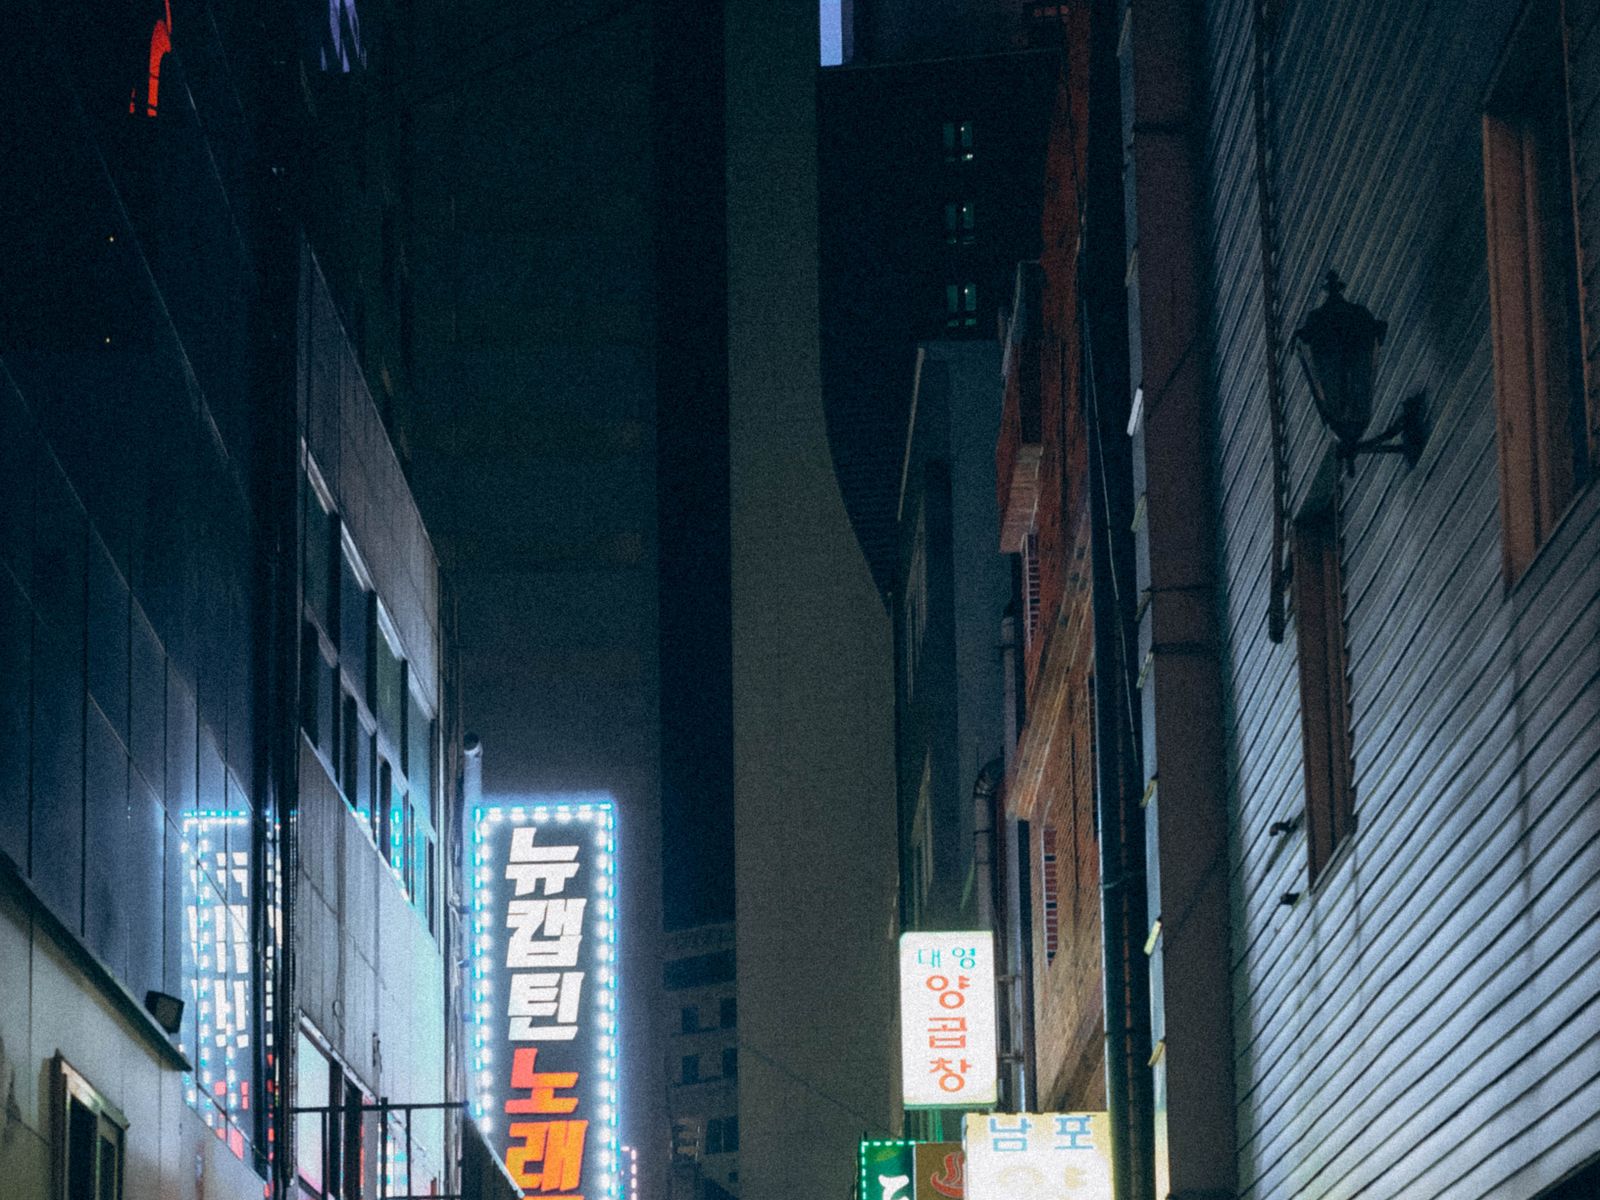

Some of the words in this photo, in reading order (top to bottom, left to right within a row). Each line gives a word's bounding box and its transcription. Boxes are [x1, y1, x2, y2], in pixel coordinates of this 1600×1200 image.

[505, 827, 588, 1042] 뉴캡틴
[916, 946, 977, 970] 대영
[925, 974, 973, 1093] 양곱창
[989, 1115, 1094, 1153] 남포
